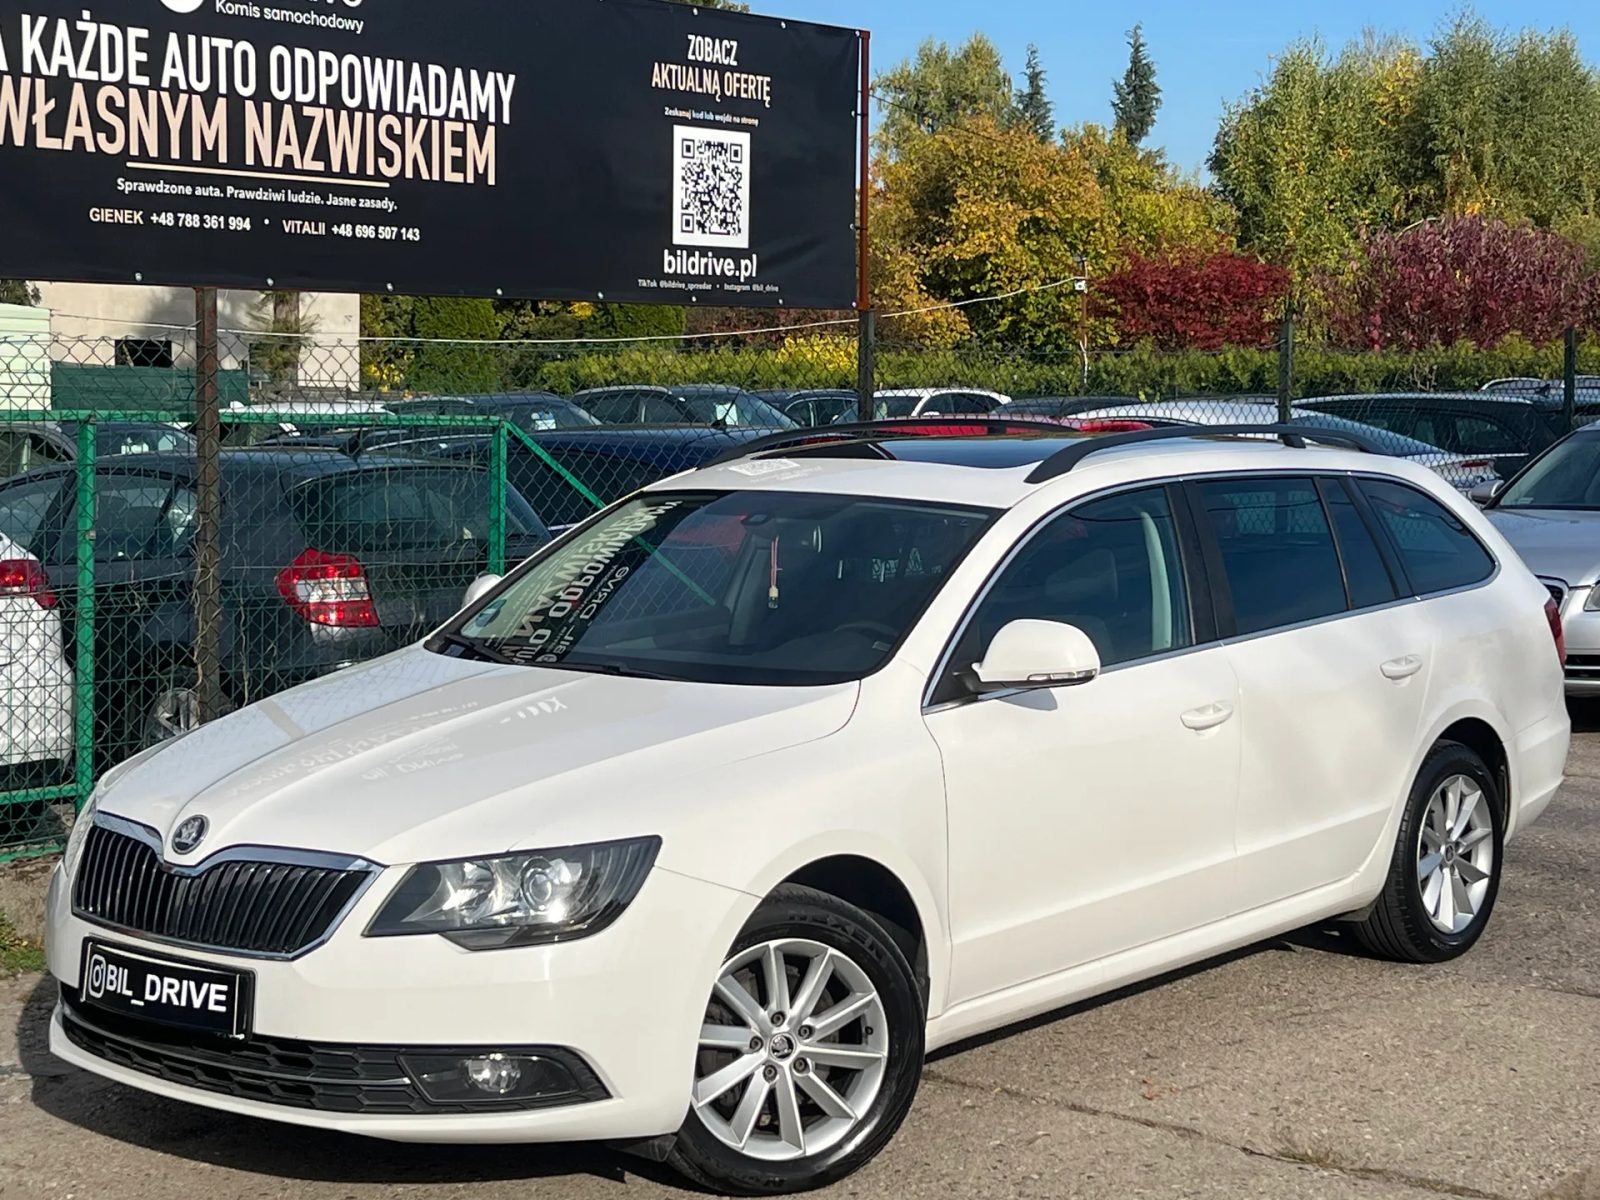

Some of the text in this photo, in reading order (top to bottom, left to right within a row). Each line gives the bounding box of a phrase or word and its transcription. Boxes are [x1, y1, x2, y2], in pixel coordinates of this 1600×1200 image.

[215, 0, 364, 35] Komis samochodowy
[21, 10, 150, 86] KAŻDE
[161, 32, 257, 97] AUTO
[269, 45, 516, 125] ODPOWIADAMY
[687, 34, 738, 66] ZOBACZ
[651, 62, 771, 108] AKTUALNĄ OFERTĘ
[0, 74, 496, 186] WŁASNYM NAZWISKIEM
[117, 177, 398, 213] Sprawdzone auta. Prawdziwi ludzie. Jasne zasady.
[89, 207, 251, 231] GIENEK +48 788 361 994
[282, 219, 420, 242] VITALII +48 696 507 143
[663, 249, 758, 282] bildrive.pl
[105, 963, 229, 1013] BIL_DRIVE
